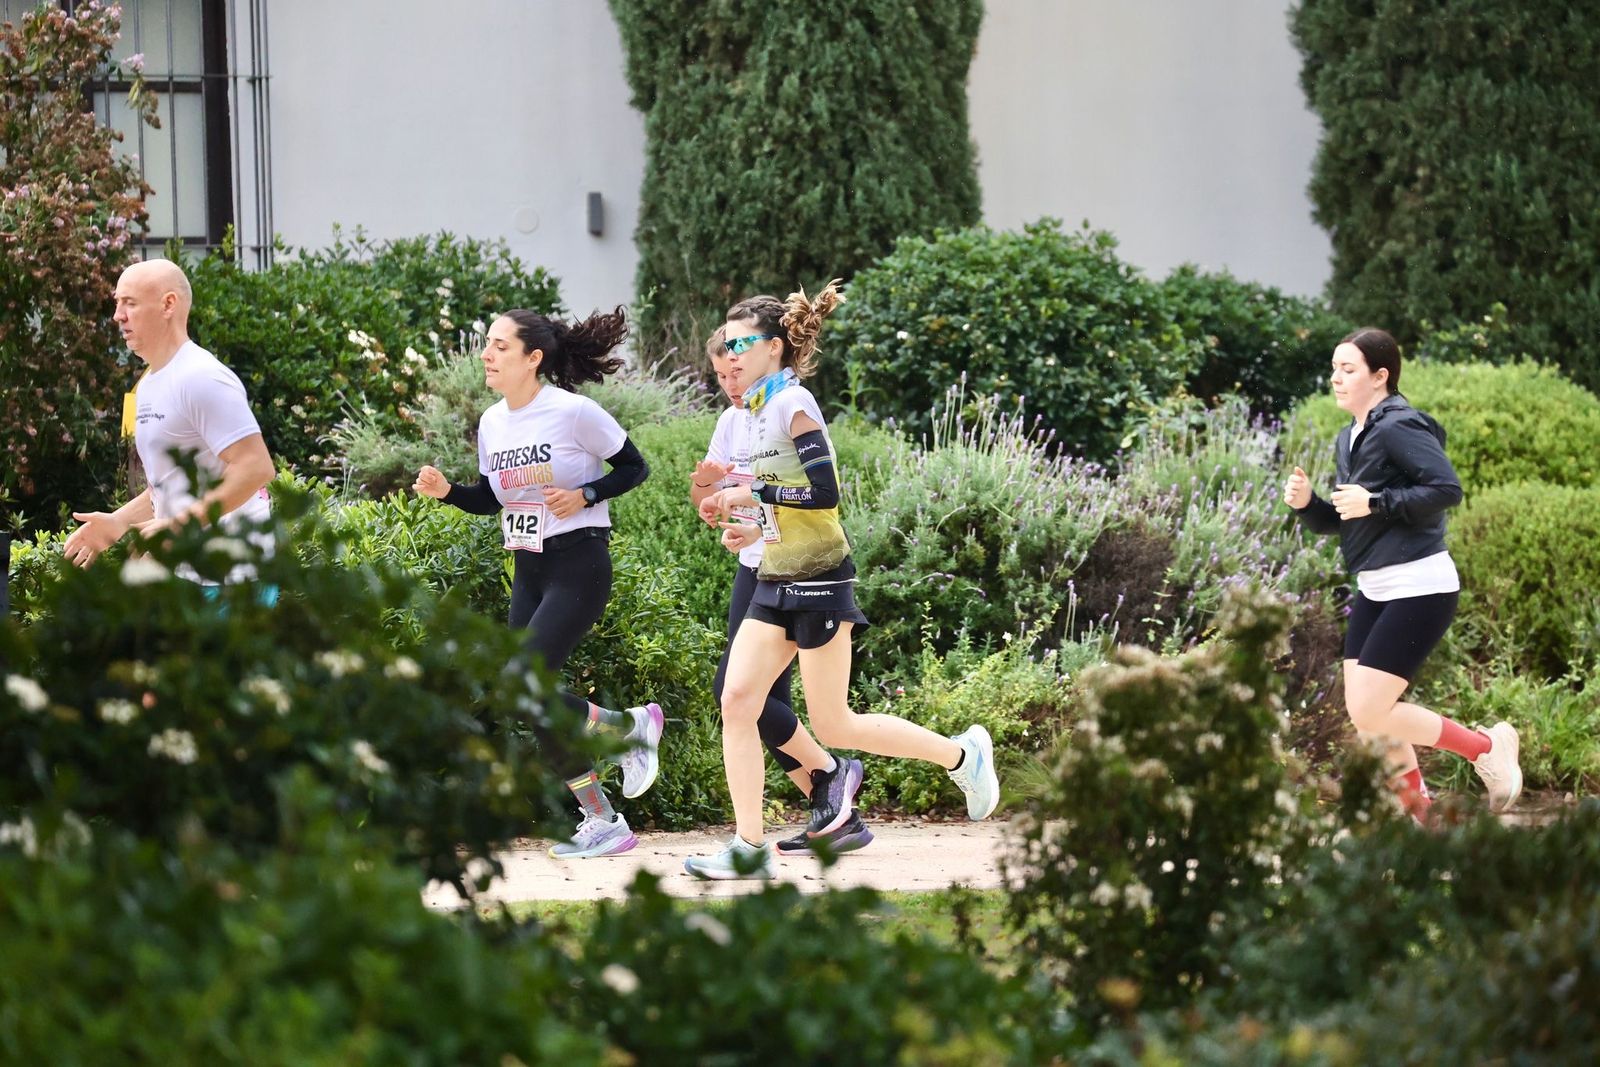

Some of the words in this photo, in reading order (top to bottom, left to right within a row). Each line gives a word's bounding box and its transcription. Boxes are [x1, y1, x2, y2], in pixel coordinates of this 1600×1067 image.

[499, 463, 554, 491] amazonas
[781, 490, 812, 501] TRIATLÓN
[506, 513, 539, 535] 142
